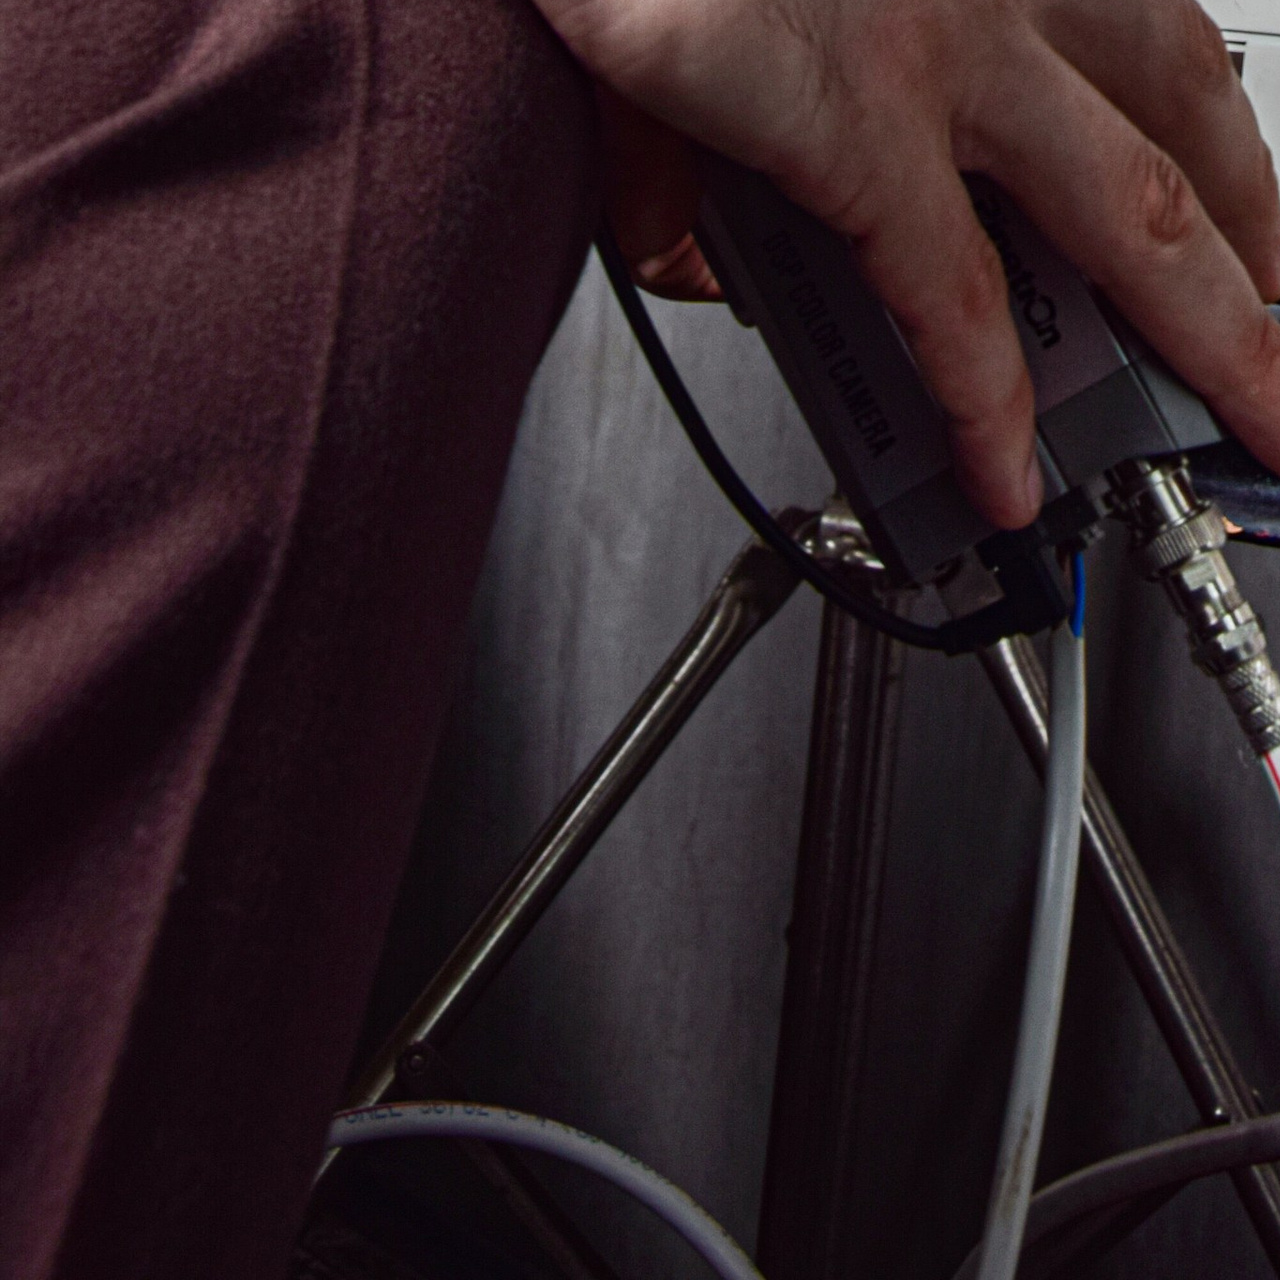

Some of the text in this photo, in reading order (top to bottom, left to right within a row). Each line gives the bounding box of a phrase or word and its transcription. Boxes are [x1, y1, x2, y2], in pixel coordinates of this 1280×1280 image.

[760, 230, 898, 459] DSP COLOR CAMERA
